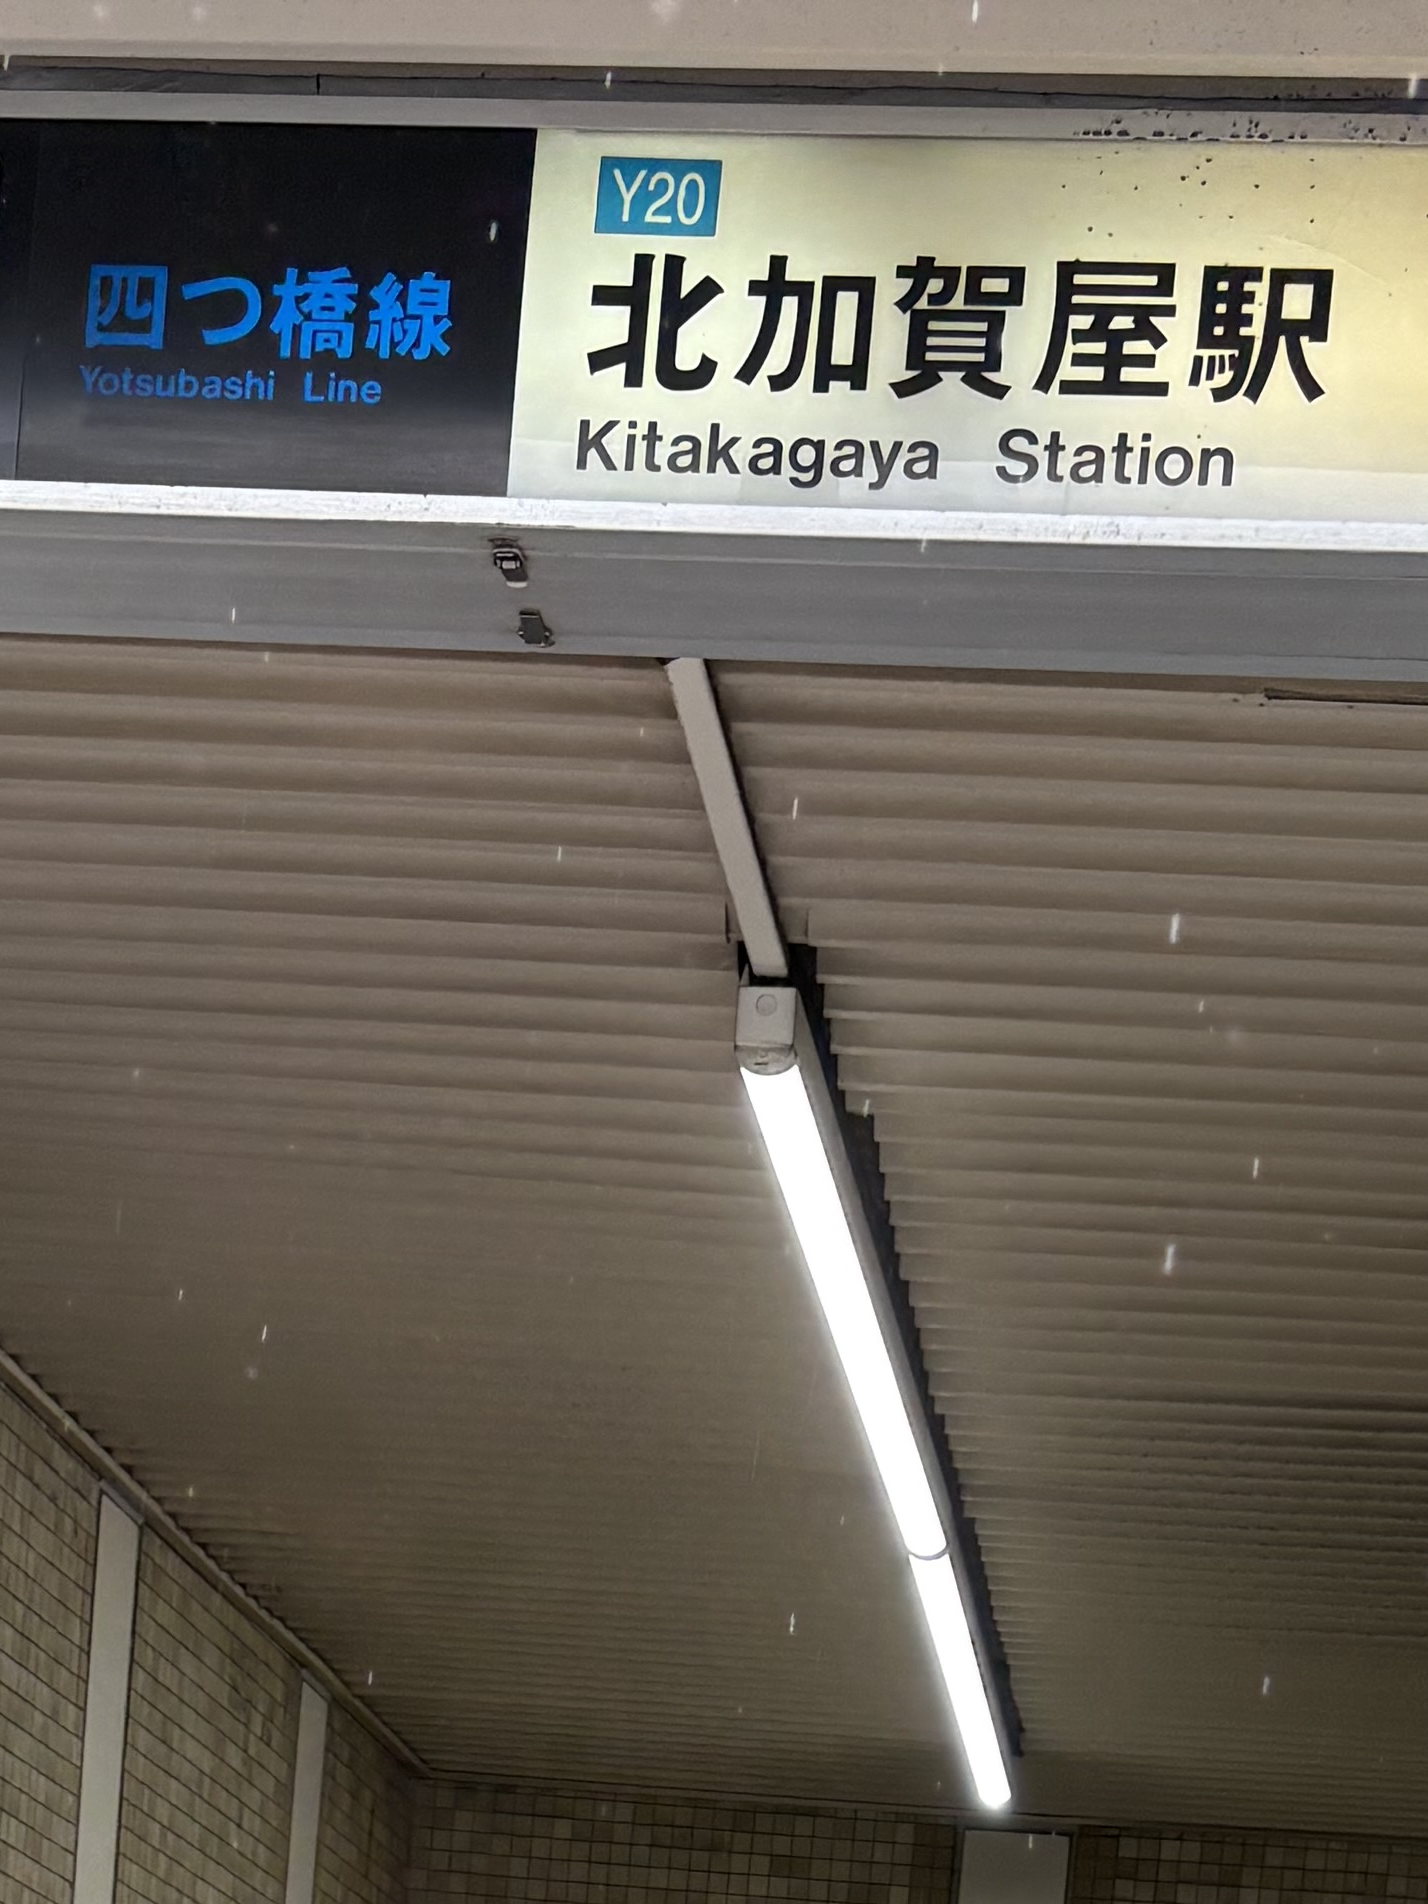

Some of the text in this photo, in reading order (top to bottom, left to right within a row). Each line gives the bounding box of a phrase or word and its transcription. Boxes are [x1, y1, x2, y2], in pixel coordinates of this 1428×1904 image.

[613, 168, 706, 226] Y20
[86, 266, 452, 361] 四つ橋線
[586, 252, 1334, 405] 北加賀屋駅
[80, 366, 382, 406] Yotsubashi Line
[576, 419, 1234, 491] Kitakagaya Station
